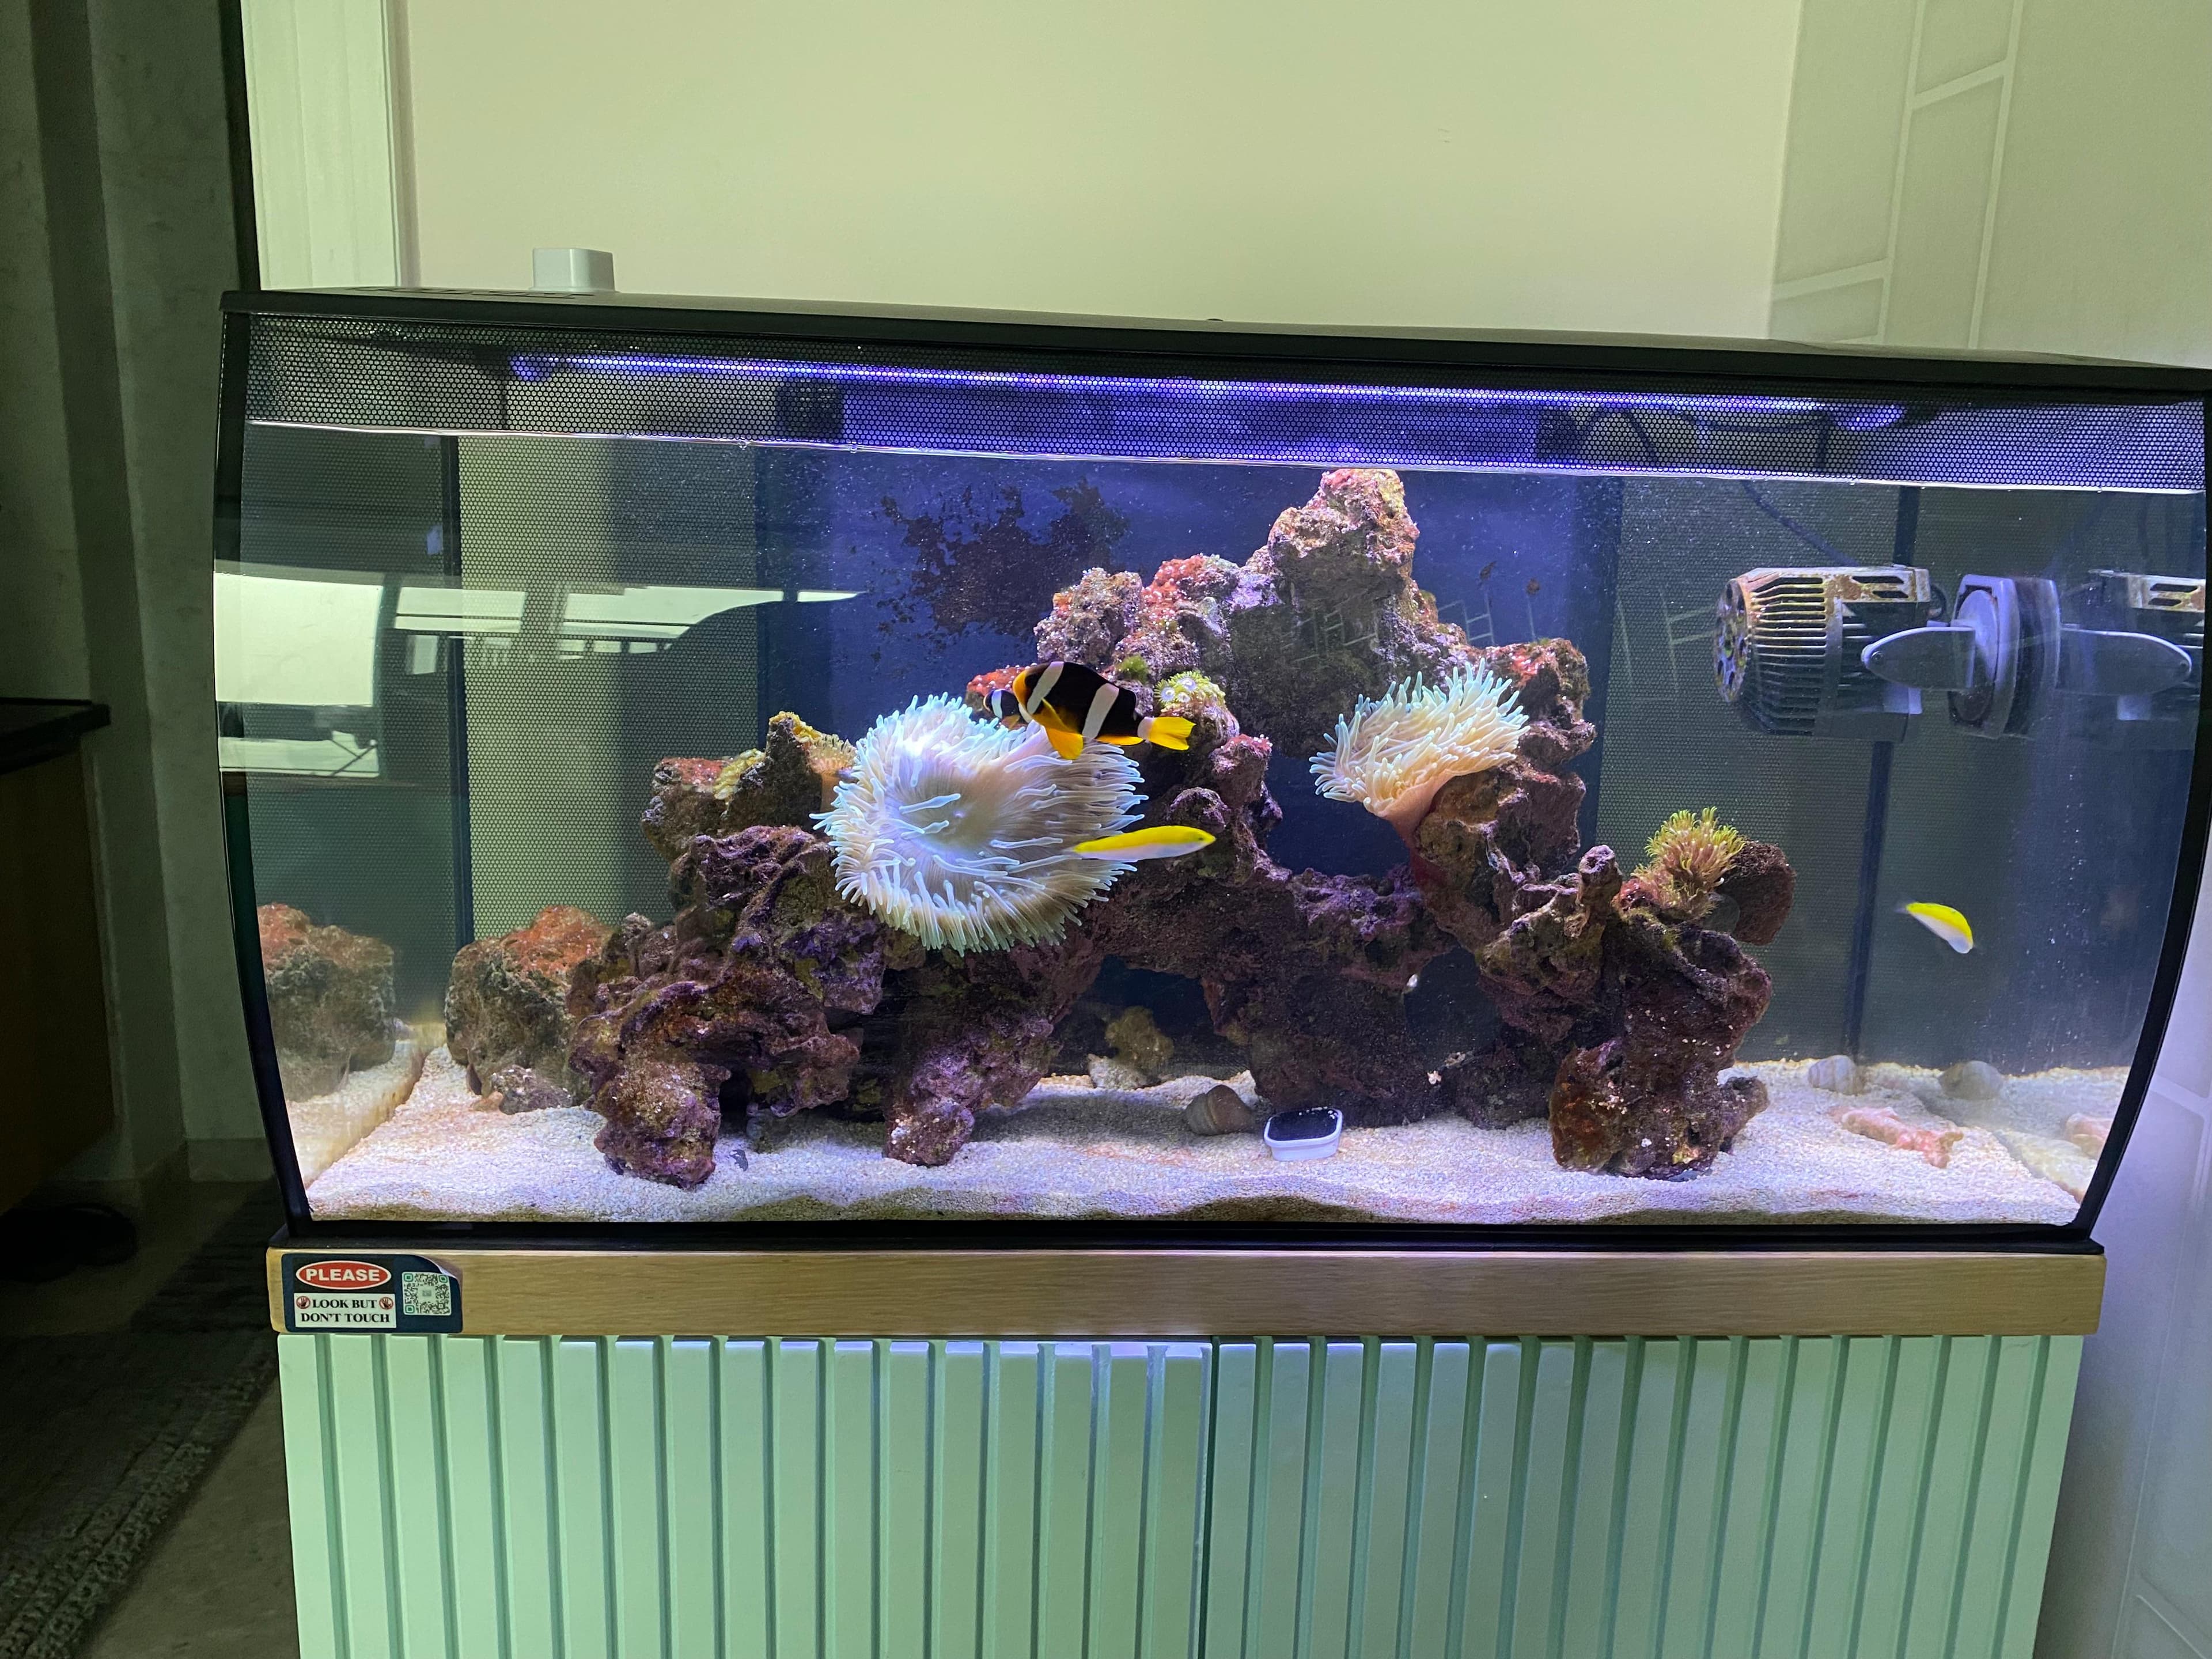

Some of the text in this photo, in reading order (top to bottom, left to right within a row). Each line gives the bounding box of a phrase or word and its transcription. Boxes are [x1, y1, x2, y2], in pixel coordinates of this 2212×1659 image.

[306, 1268, 380, 1281] PLEASE
[313, 1299, 377, 1308] LOOK BUT
[301, 1313, 390, 1323] DON'T TOUCH
